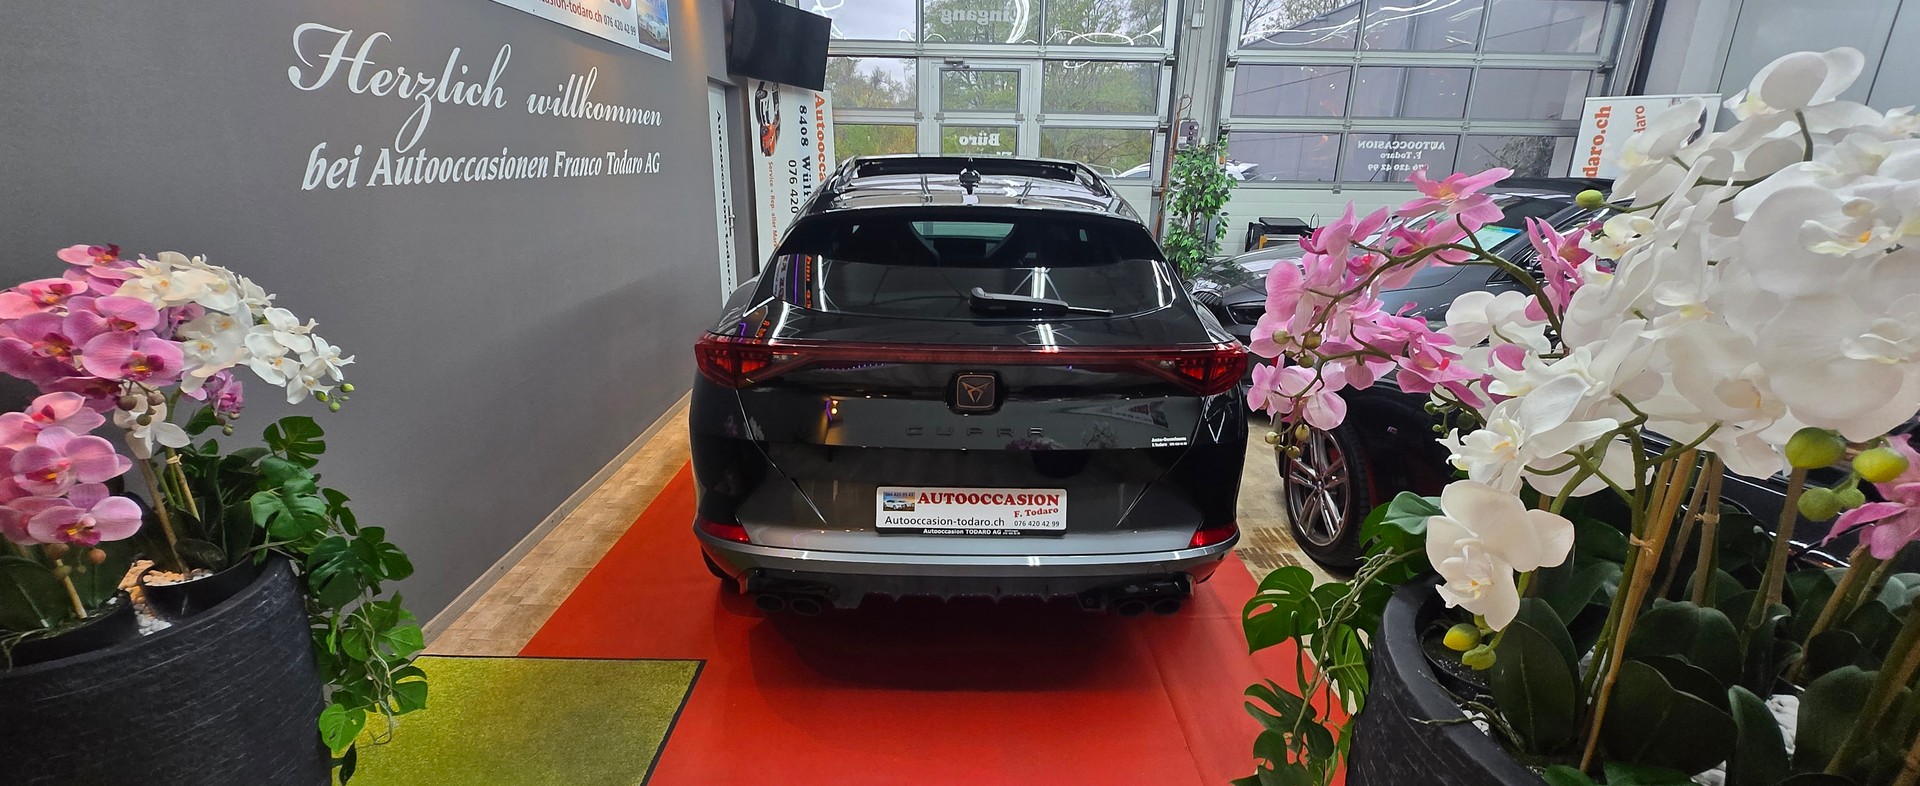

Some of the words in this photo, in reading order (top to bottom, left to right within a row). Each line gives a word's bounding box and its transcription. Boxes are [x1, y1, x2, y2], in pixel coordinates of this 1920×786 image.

[604, 15, 613, 27] 076
[614, 19, 623, 31] 420
[624, 24, 630, 34] 42
[630, 26, 636, 36] 99
[288, 23, 511, 153] Herzlich
[527, 67, 662, 126] willkommen
[799, 105, 809, 147] 8408
[1583, 105, 1612, 178] daro.ch
[301, 142, 362, 190] bei
[366, 147, 548, 187] Autooccasionen
[553, 150, 602, 178] Franco
[606, 149, 642, 175] Todaro
[644, 152, 660, 174] AG
[788, 160, 798, 185] 076
[802, 155, 811, 202] Wülf
[790, 189, 799, 214] 420
[917, 492, 1060, 506] AUTOOCCASION
[885, 516, 1004, 527] Autooccasion-todaro.ch
[1024, 508, 1059, 517] Todaro
